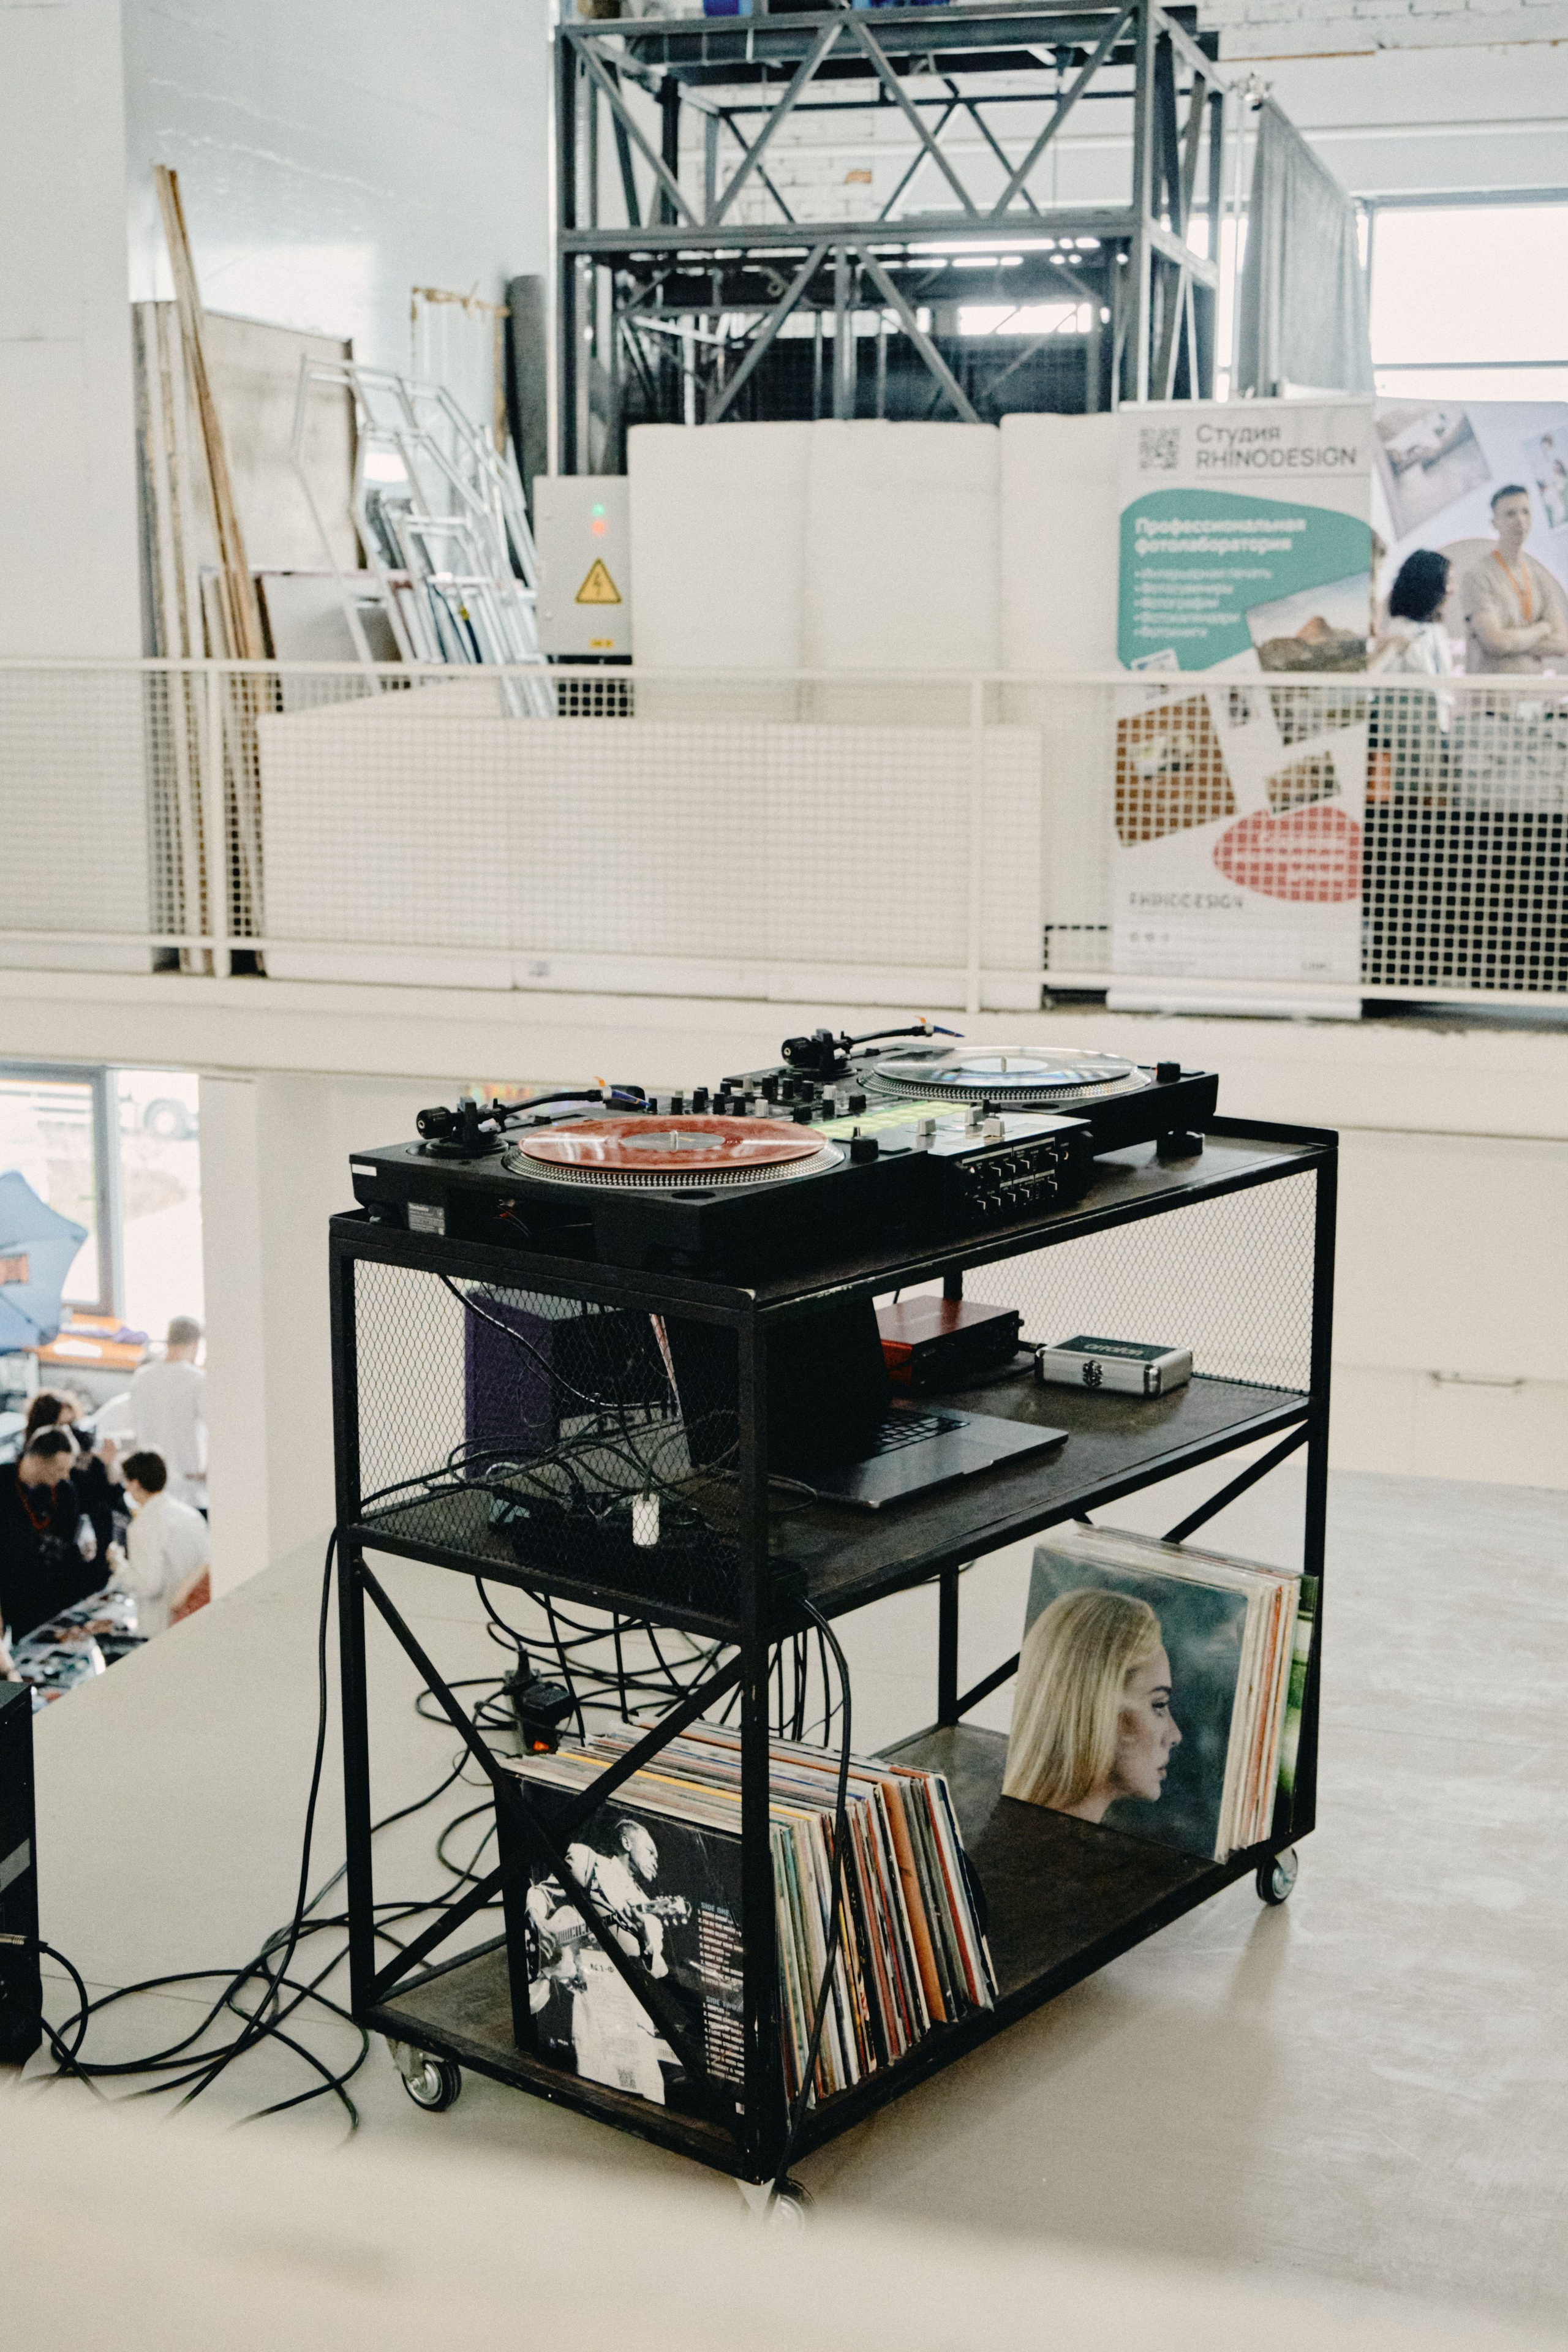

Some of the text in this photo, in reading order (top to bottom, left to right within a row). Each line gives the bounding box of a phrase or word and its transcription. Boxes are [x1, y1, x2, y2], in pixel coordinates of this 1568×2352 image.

[1196, 423, 1281, 447] Студия
[1196, 447, 1357, 468] RHINODESIGN
[700, 1902, 729, 1917] SIDE ONE
[706, 1996, 720, 2006] SIDE
